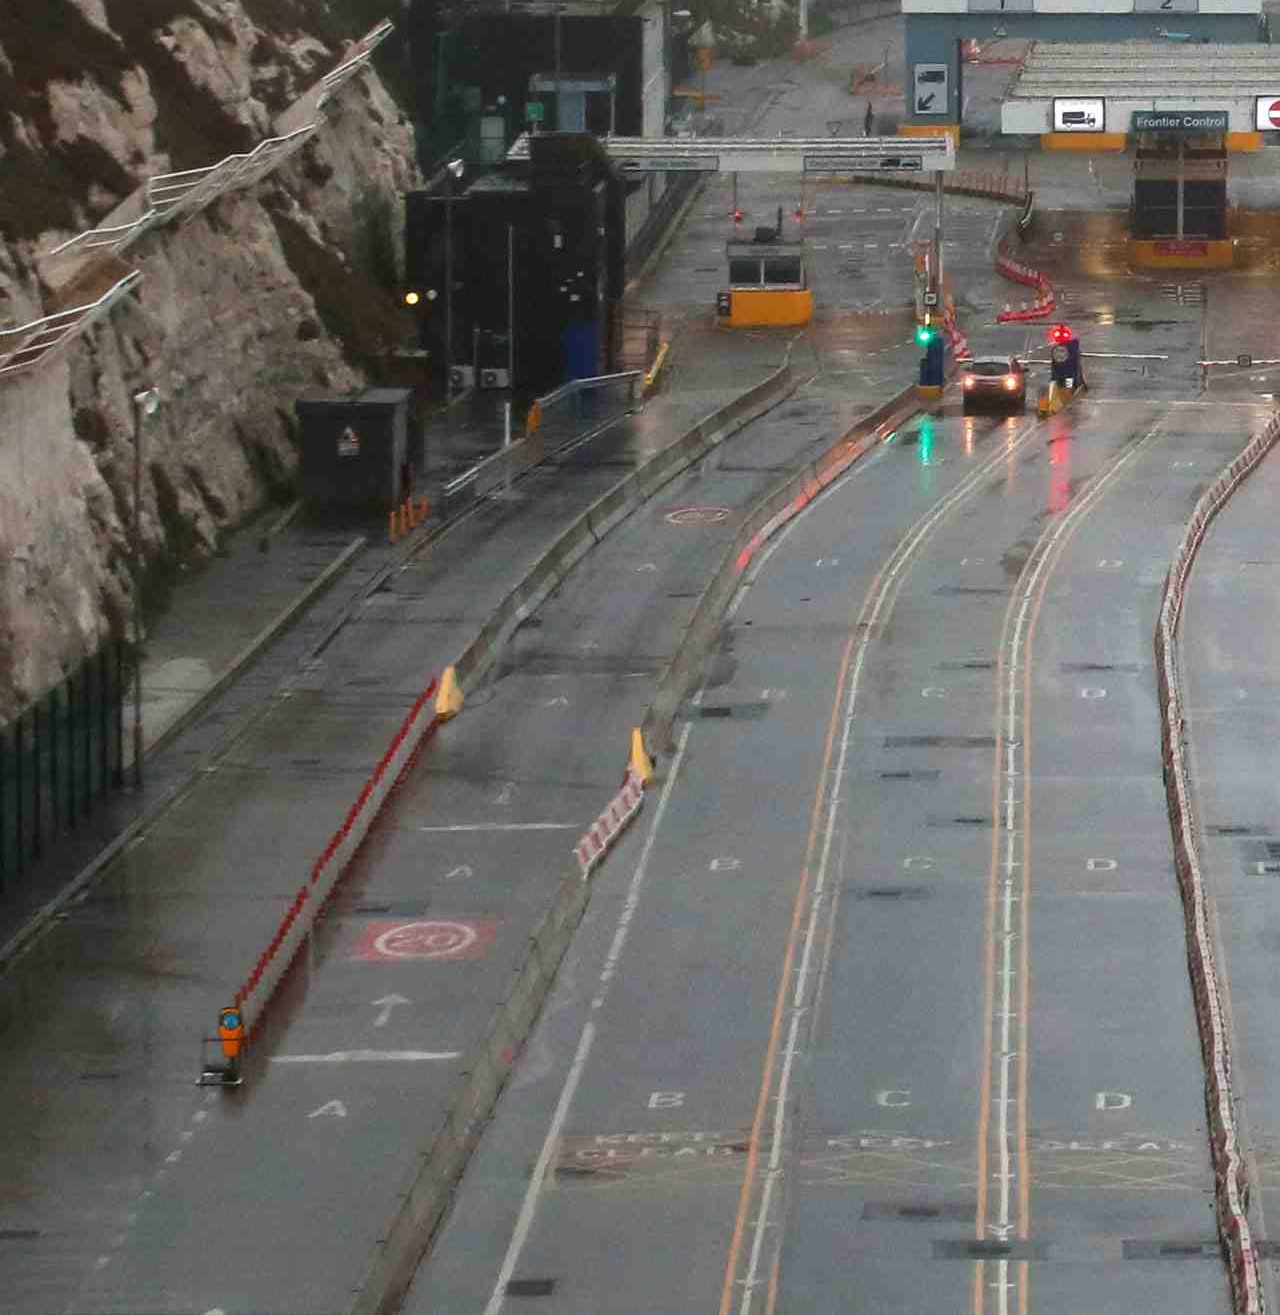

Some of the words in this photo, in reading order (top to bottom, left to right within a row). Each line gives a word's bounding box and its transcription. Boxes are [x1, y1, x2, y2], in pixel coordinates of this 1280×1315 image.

[1136, 117, 1180, 127] Frontier
[1183, 117, 1225, 127] Control
[1086, 857, 1118, 871] D
[388, 929, 463, 949] 20
[648, 1090, 688, 1109] B
[875, 1089, 912, 1108] C
[1095, 1092, 1132, 1111] D
[308, 1099, 349, 1119] A
